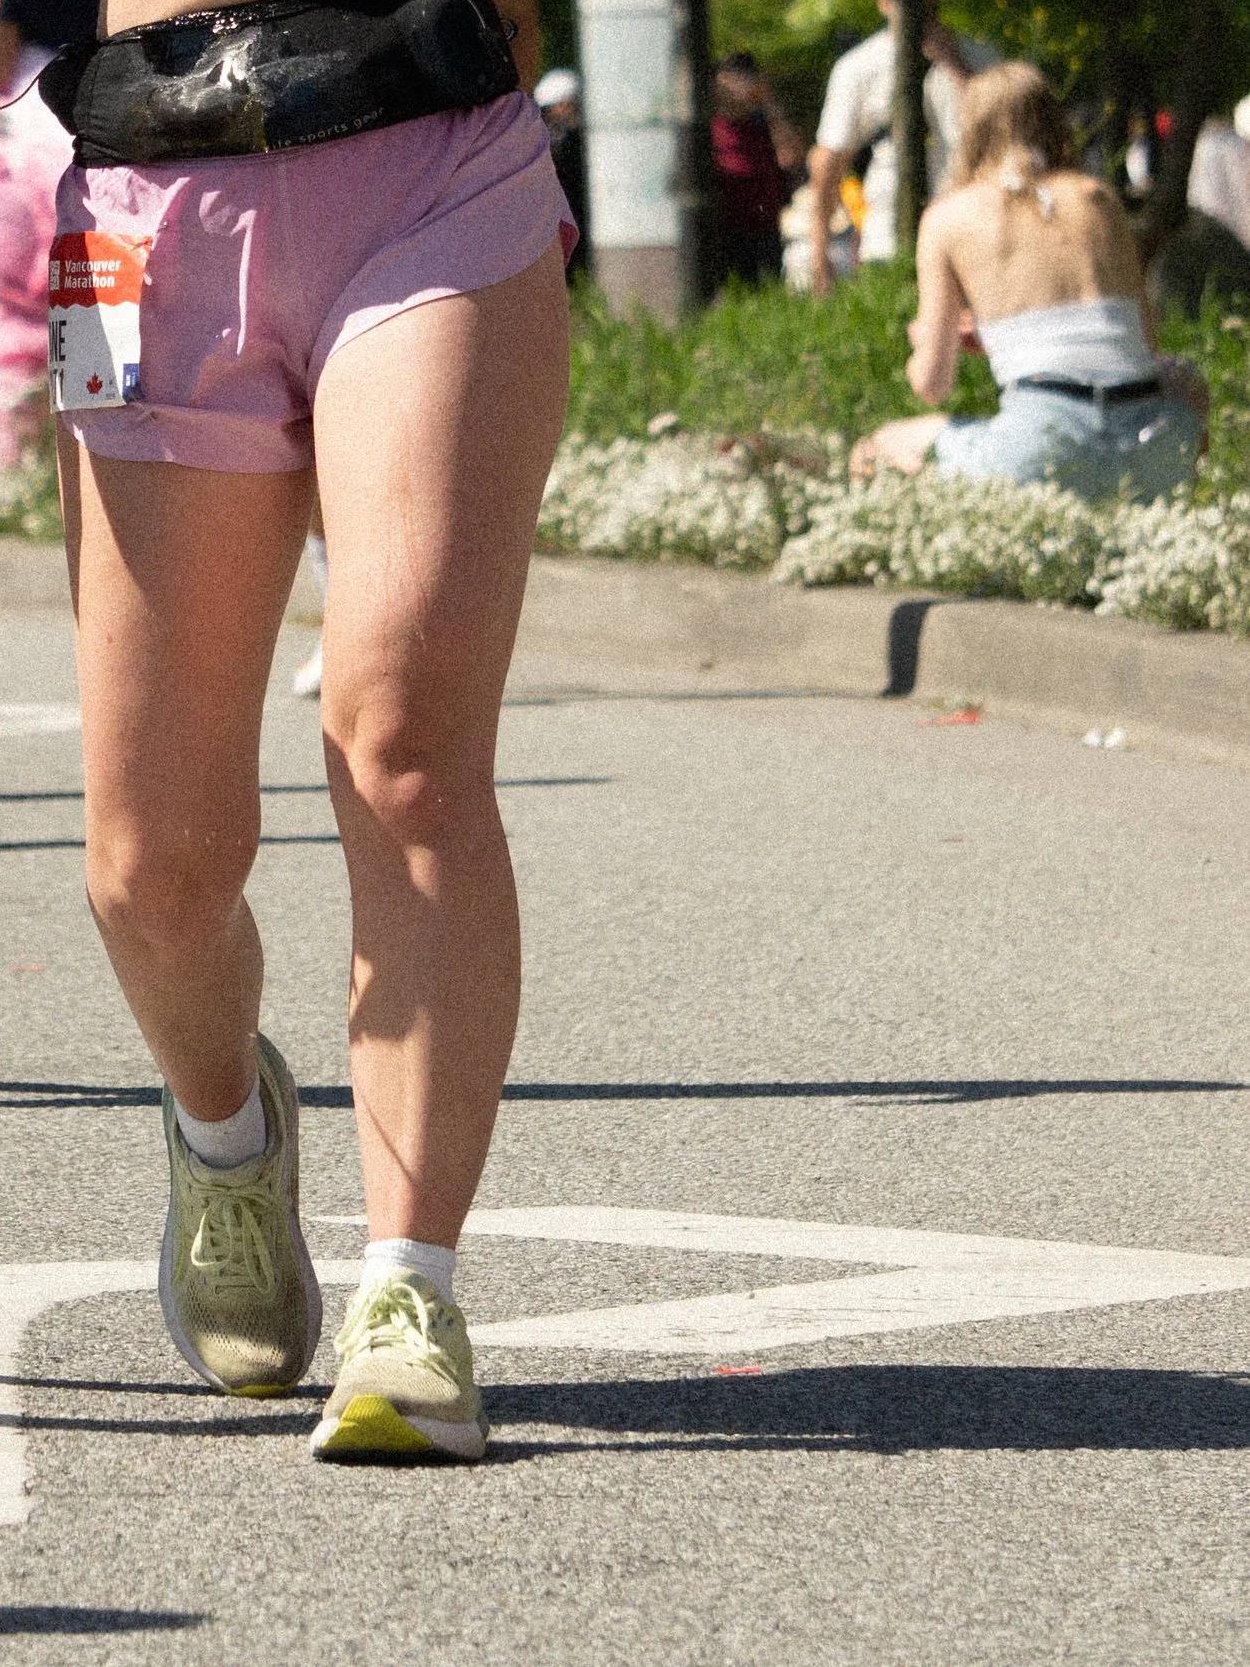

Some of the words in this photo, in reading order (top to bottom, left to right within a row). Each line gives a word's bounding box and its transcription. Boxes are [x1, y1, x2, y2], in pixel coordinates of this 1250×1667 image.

[299, 123, 348, 142] sports
[353, 107, 383, 129] gear
[65, 259, 121, 273] Vancouver
[64, 272, 115, 288] Marathon
